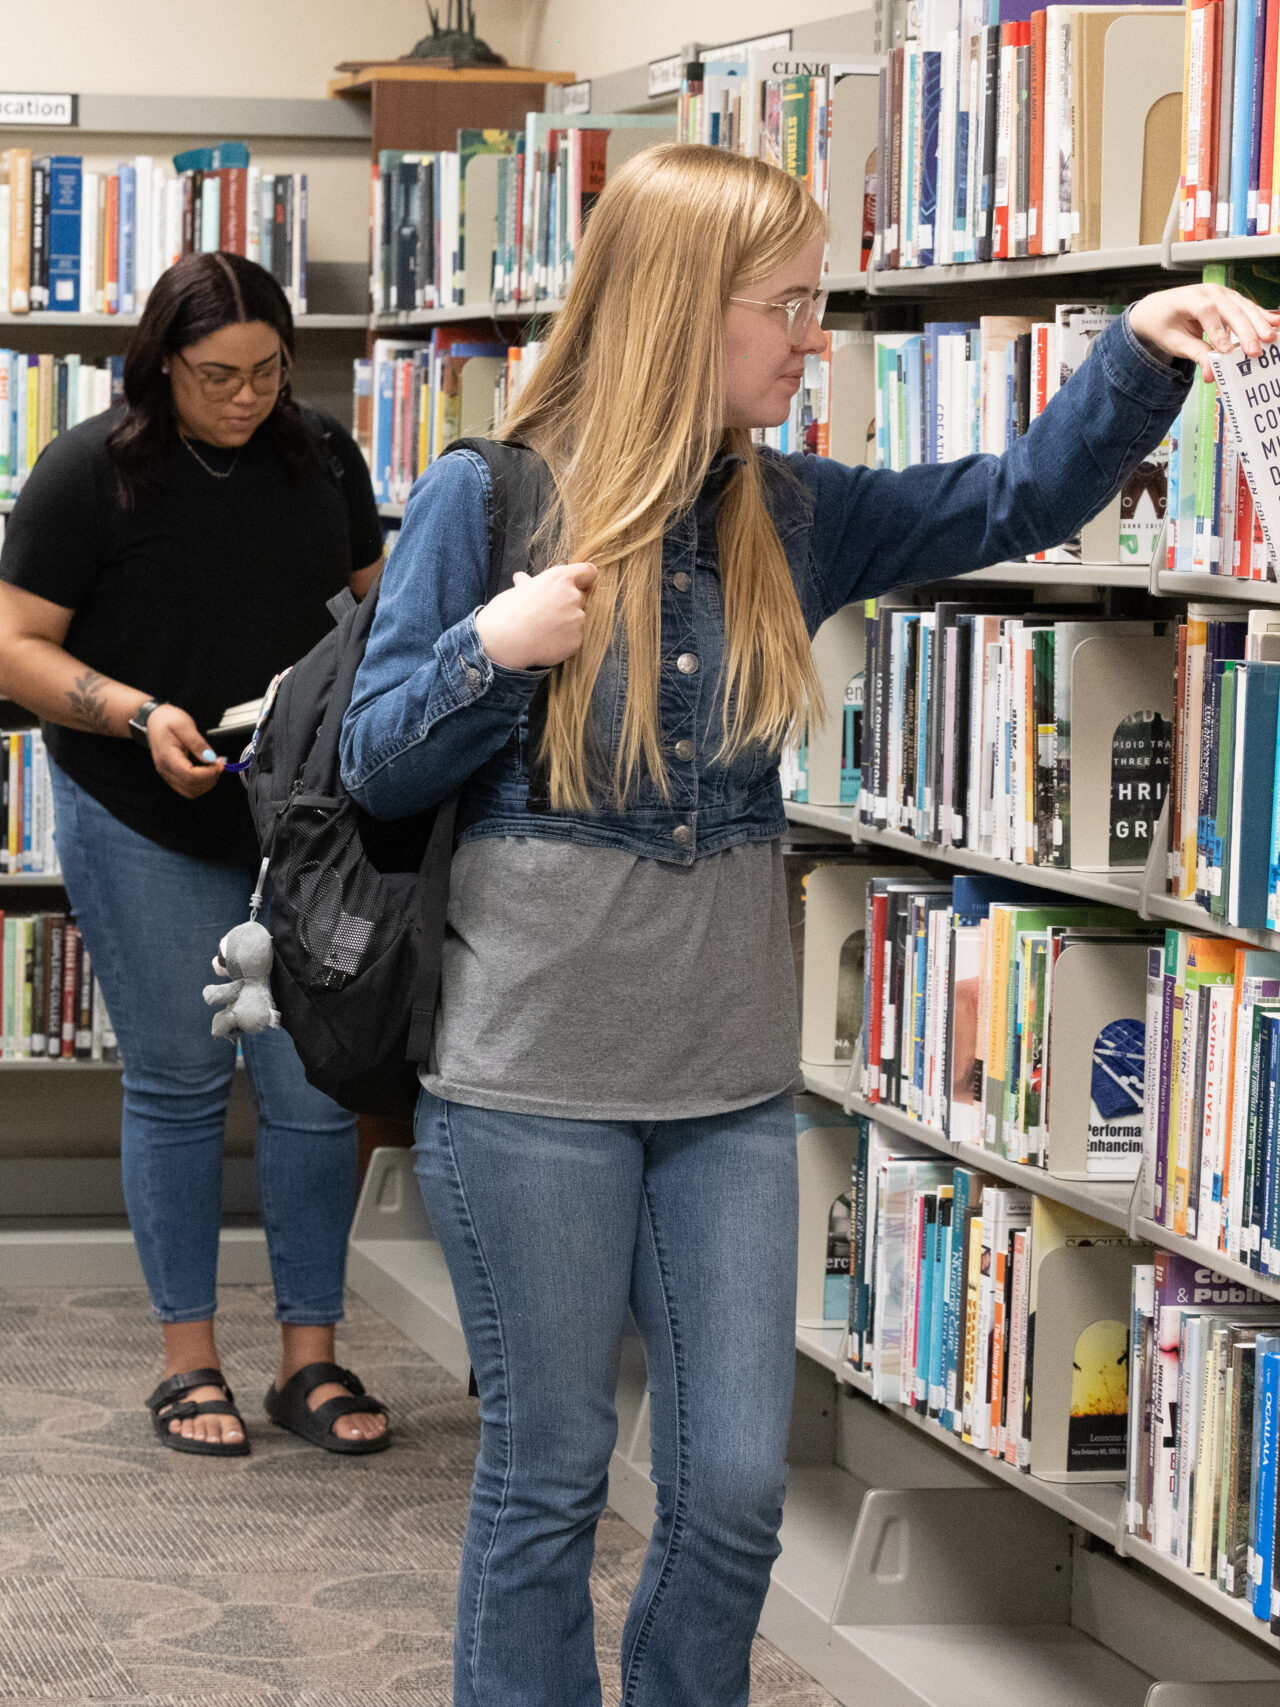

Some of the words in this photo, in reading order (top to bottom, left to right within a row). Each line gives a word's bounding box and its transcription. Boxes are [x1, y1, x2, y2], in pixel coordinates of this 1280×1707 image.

[1212, 361, 1226, 386] BAD
[1222, 391, 1243, 444] PHARMA
[1246, 471, 1258, 495] BEN
[873, 706, 882, 796] CONNECTIONS
[1113, 757, 1150, 765] THREE
[1150, 740, 1172, 748] TRA
[1110, 782, 1162, 801] HRI
[990, 979, 999, 1071] ENCYCLOPEDIA
[1163, 981, 1172, 1034] Nursing
[1162, 1038, 1170, 1072] Care
[1184, 995, 1194, 1088] COMPREHENSIVE
[1209, 1000, 1218, 1072] SAVING
[1160, 1075, 1169, 1112] Plans
[1205, 1082, 1214, 1137] LIVES
[1087, 1124, 1142, 1137] erforma
[949, 1251, 958, 1312] Nursing
[1176, 1287, 1189, 1303] &
[1200, 1360, 1209, 1437] CHIROPRACTIC
[1089, 1433, 1121, 1442] Lessons
[1263, 1392, 1272, 1466] OGALLALA
